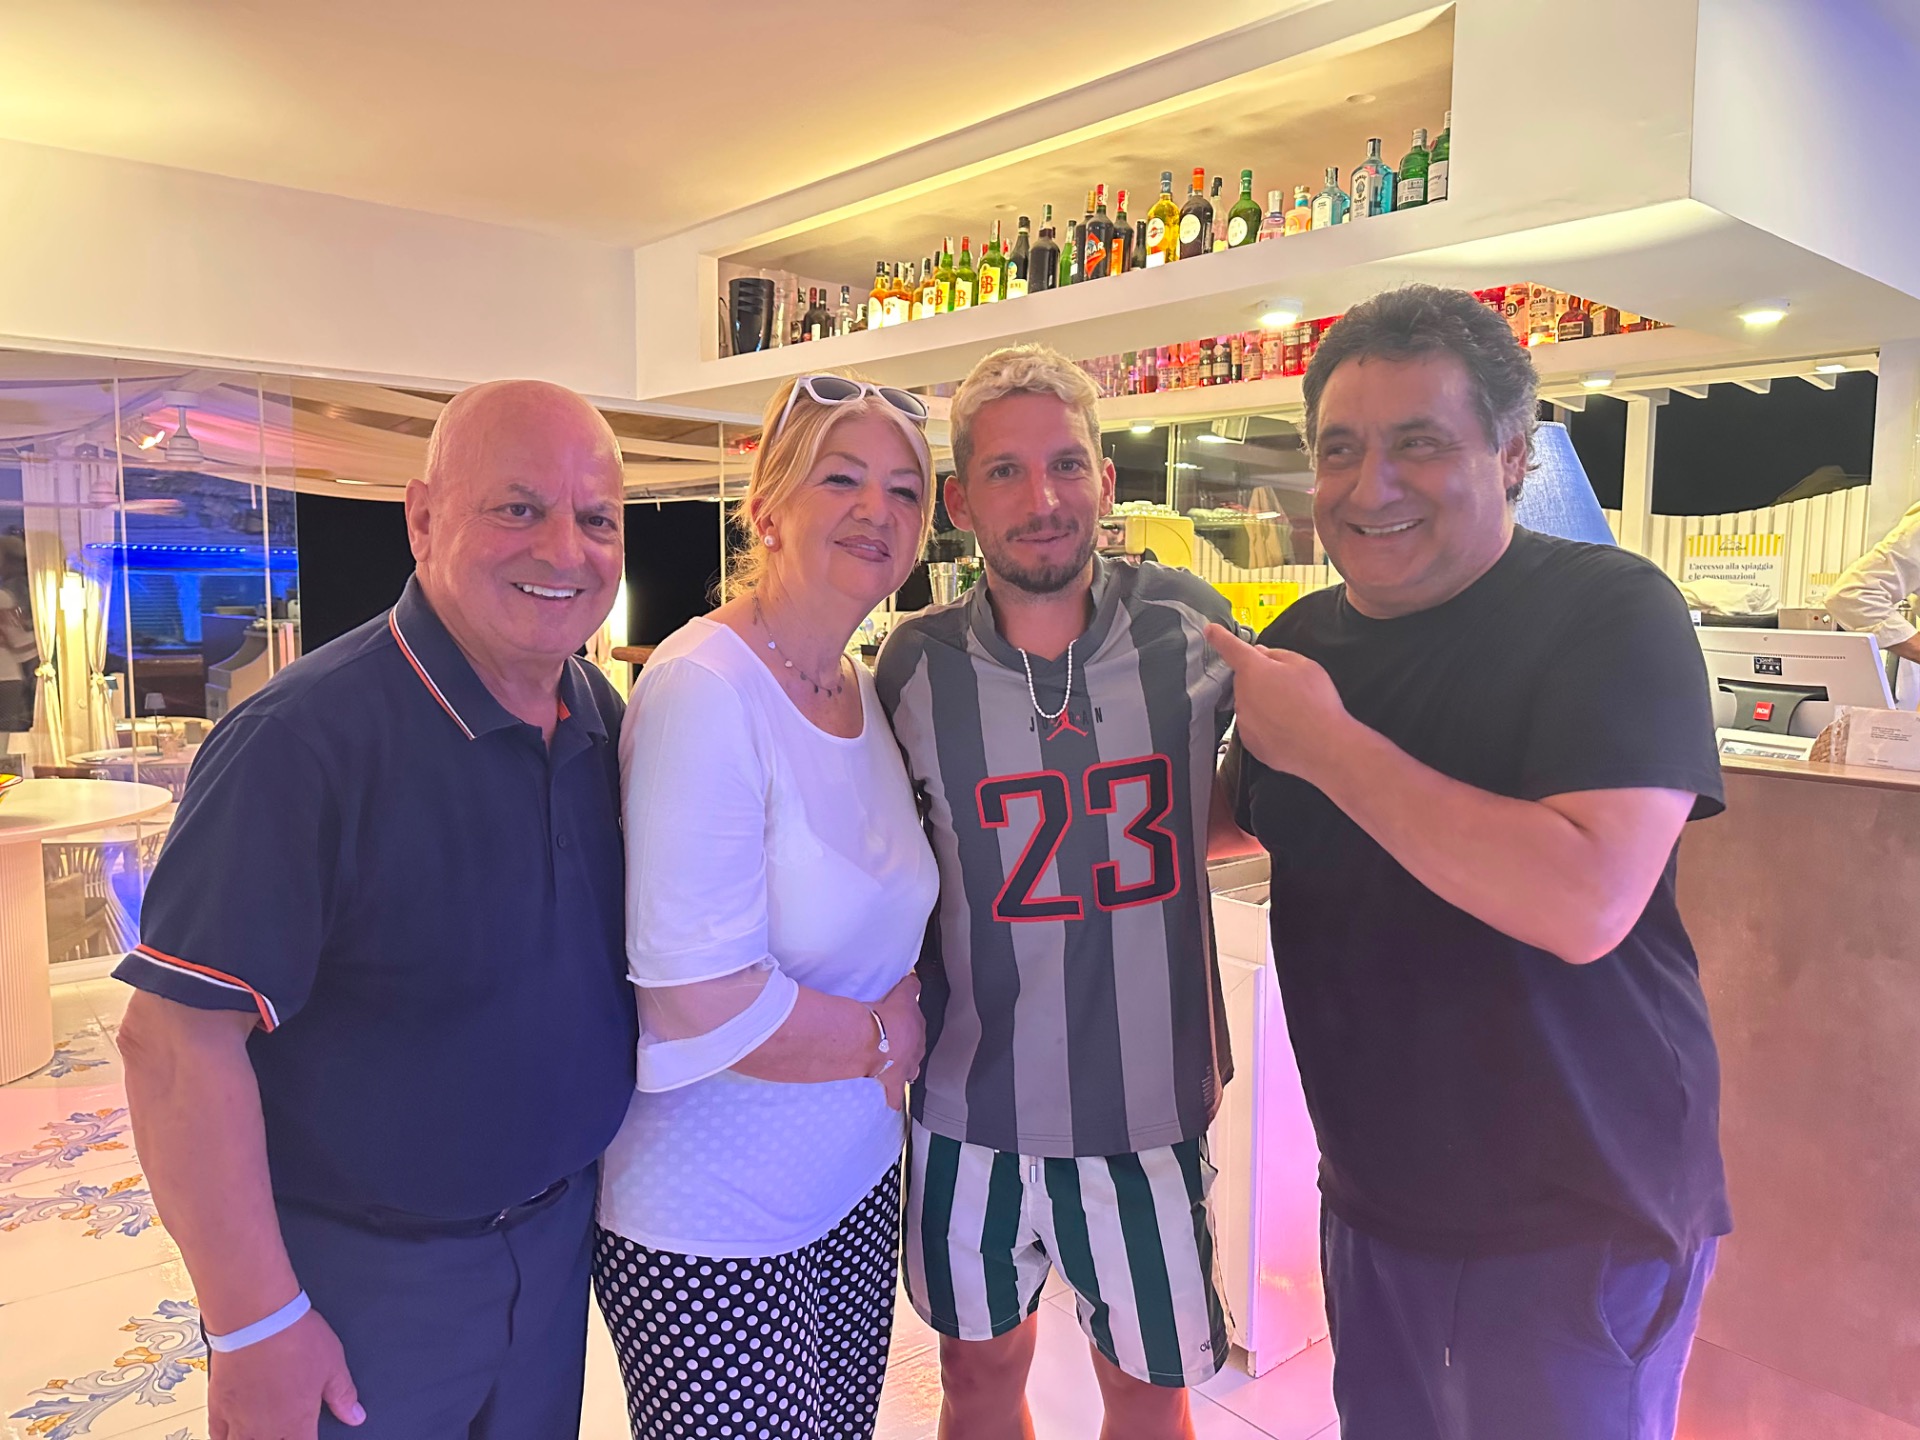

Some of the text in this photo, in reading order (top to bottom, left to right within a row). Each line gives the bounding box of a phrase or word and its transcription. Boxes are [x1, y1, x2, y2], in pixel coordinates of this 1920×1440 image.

[1086, 241, 1105, 256] NAR
[1725, 562, 1739, 570] alla
[1741, 562, 1773, 571] spiaggia
[975, 753, 1181, 922] 23
